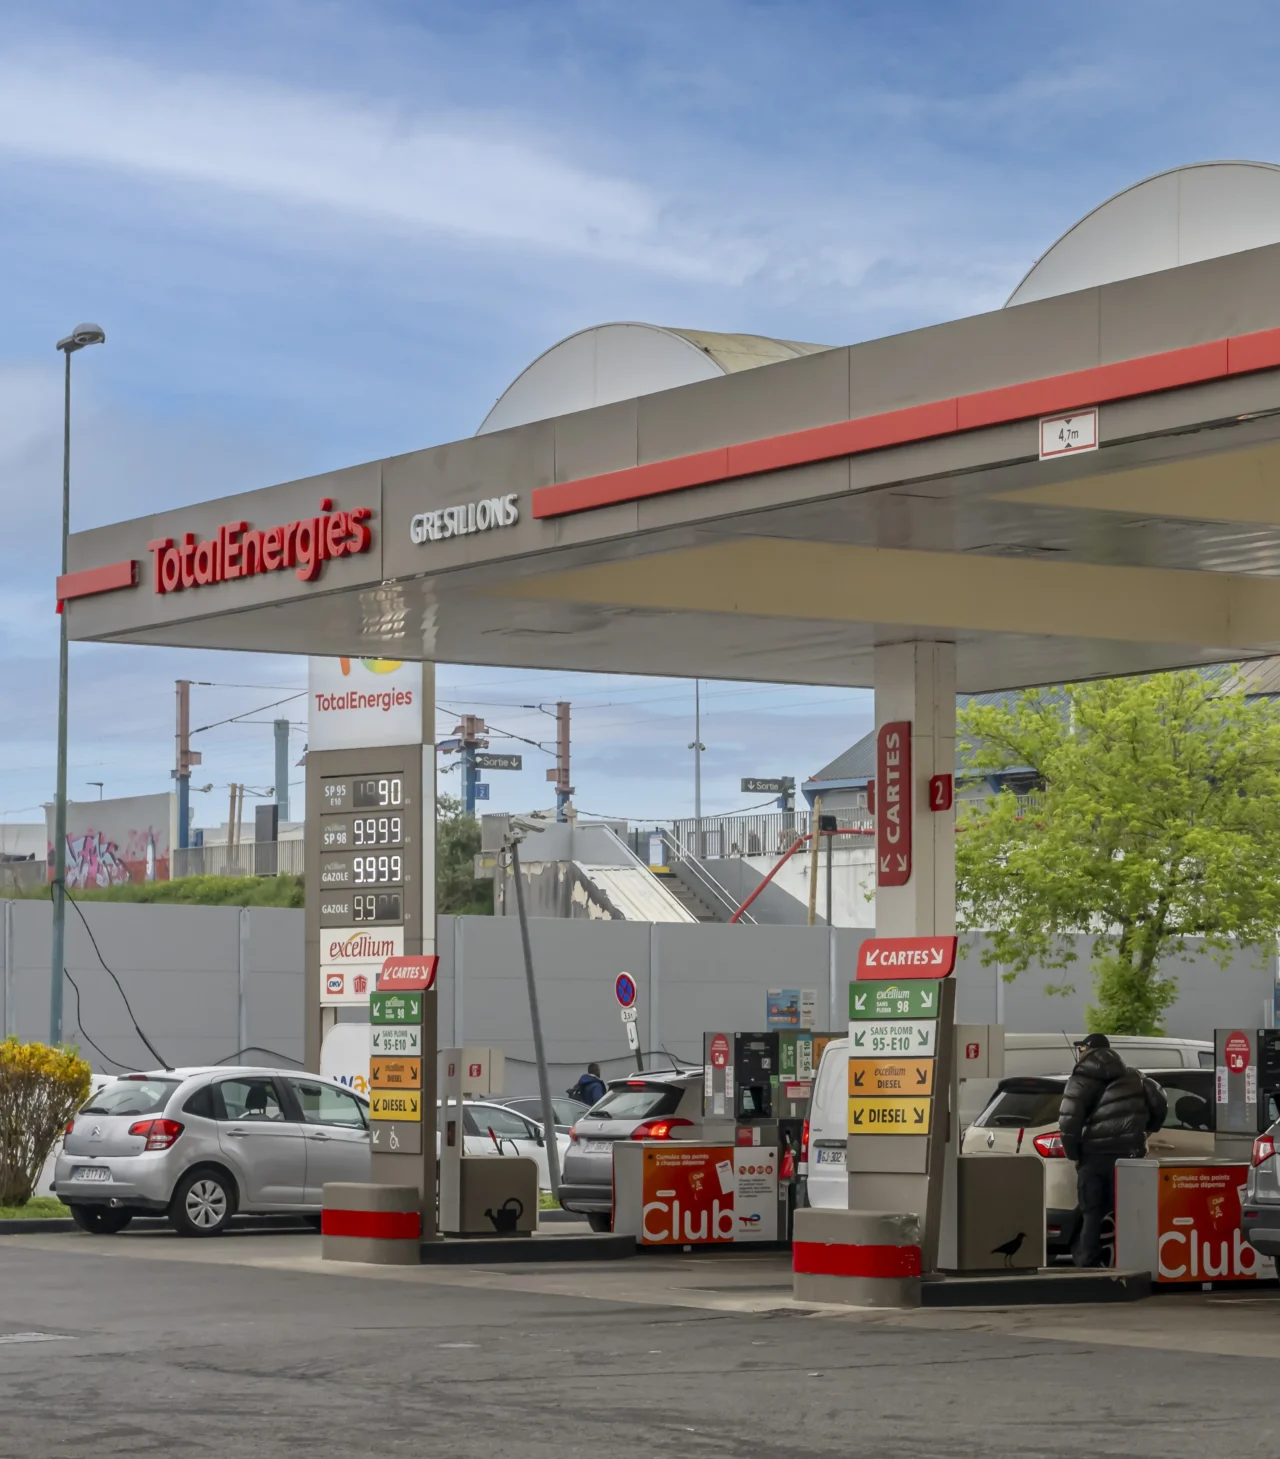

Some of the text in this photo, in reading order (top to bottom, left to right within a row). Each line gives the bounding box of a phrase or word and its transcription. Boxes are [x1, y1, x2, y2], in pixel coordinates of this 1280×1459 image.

[1058, 428, 1079, 442] 4,7m
[410, 493, 519, 544] GRESILLONS
[148, 497, 371, 594] TotalEnergies
[315, 687, 412, 711] TotalEnergies
[483, 756, 508, 766] Sortie
[324, 785, 346, 796] SP 95
[756, 781, 778, 790] Sortie
[887, 732, 899, 843] CARTES
[936, 781, 943, 804] 2
[324, 833, 346, 844] SP 98
[322, 872, 348, 882] GAZOLE
[322, 904, 348, 914] GAZOLE
[329, 935, 394, 958] excellium
[880, 950, 929, 966] CARTES
[392, 967, 420, 978] CARTES
[876, 988, 910, 999] excellium
[897, 1001, 909, 1013] 98
[398, 1008, 404, 1018] 98
[870, 1026, 913, 1036] SANS PLOMB
[384, 1039, 406, 1050] 95-E10
[872, 1037, 910, 1051] 95-E10
[763, 1059, 769, 1068] 2
[874, 1065, 906, 1077] excellium
[877, 1080, 901, 1089] DIESEL
[383, 1100, 407, 1111] DIESEL
[869, 1109, 907, 1123] DIESEL
[643, 1199, 734, 1240] Club
[1158, 1228, 1258, 1278] Club
